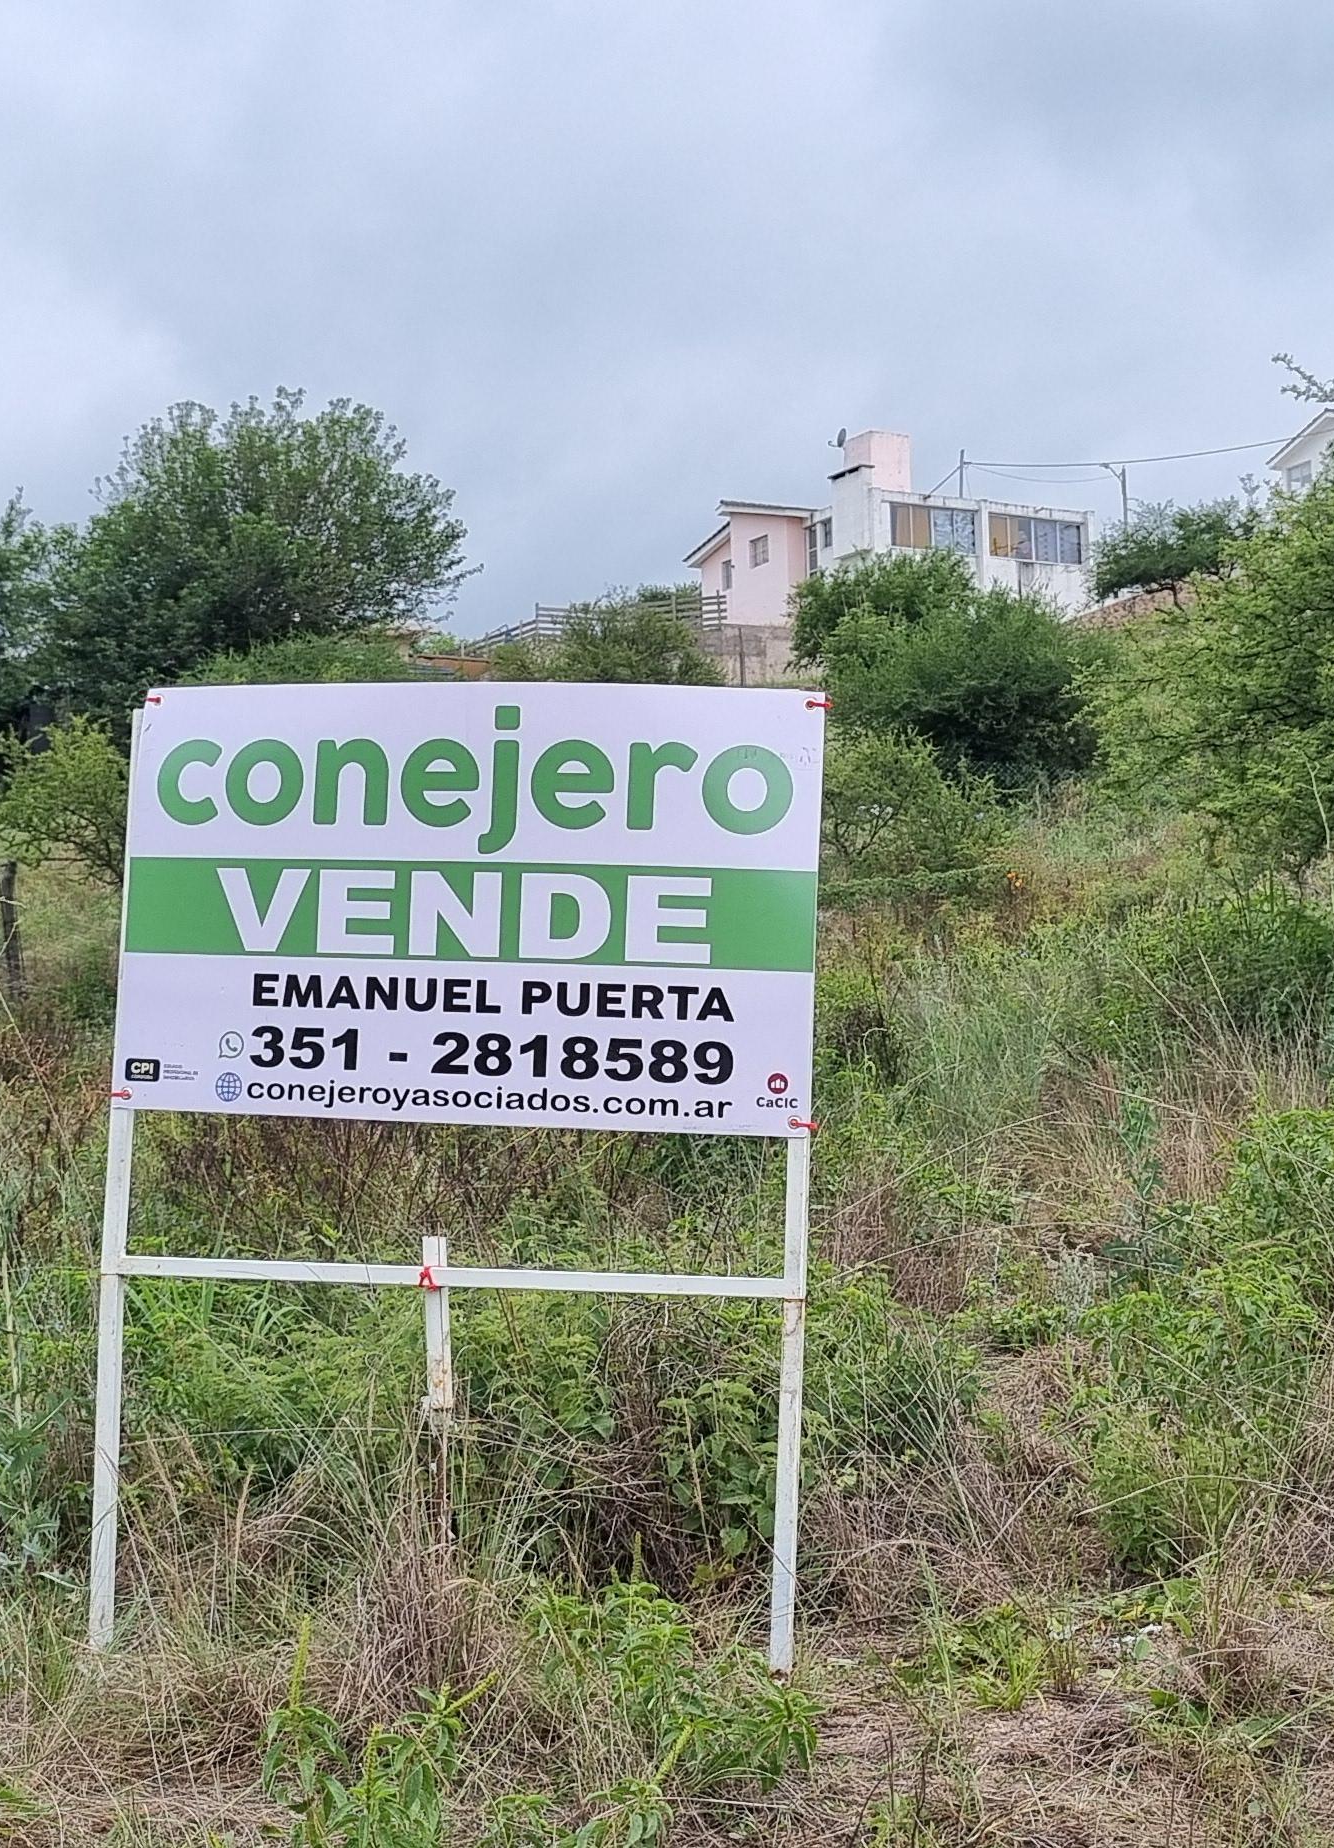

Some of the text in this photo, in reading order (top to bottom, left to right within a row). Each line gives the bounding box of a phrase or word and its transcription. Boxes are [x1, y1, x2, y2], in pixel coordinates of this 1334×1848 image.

[157, 705, 793, 854] conejero
[216, 867, 712, 964] VENDE
[253, 973, 734, 1022] EMANUEL PUERTA
[130, 1061, 154, 1074] CPI
[250, 1026, 734, 1085] 351 - 2818589
[246, 1080, 733, 1118] conejeroyasociados.com.ar
[756, 1096, 799, 1109] CaCIC
